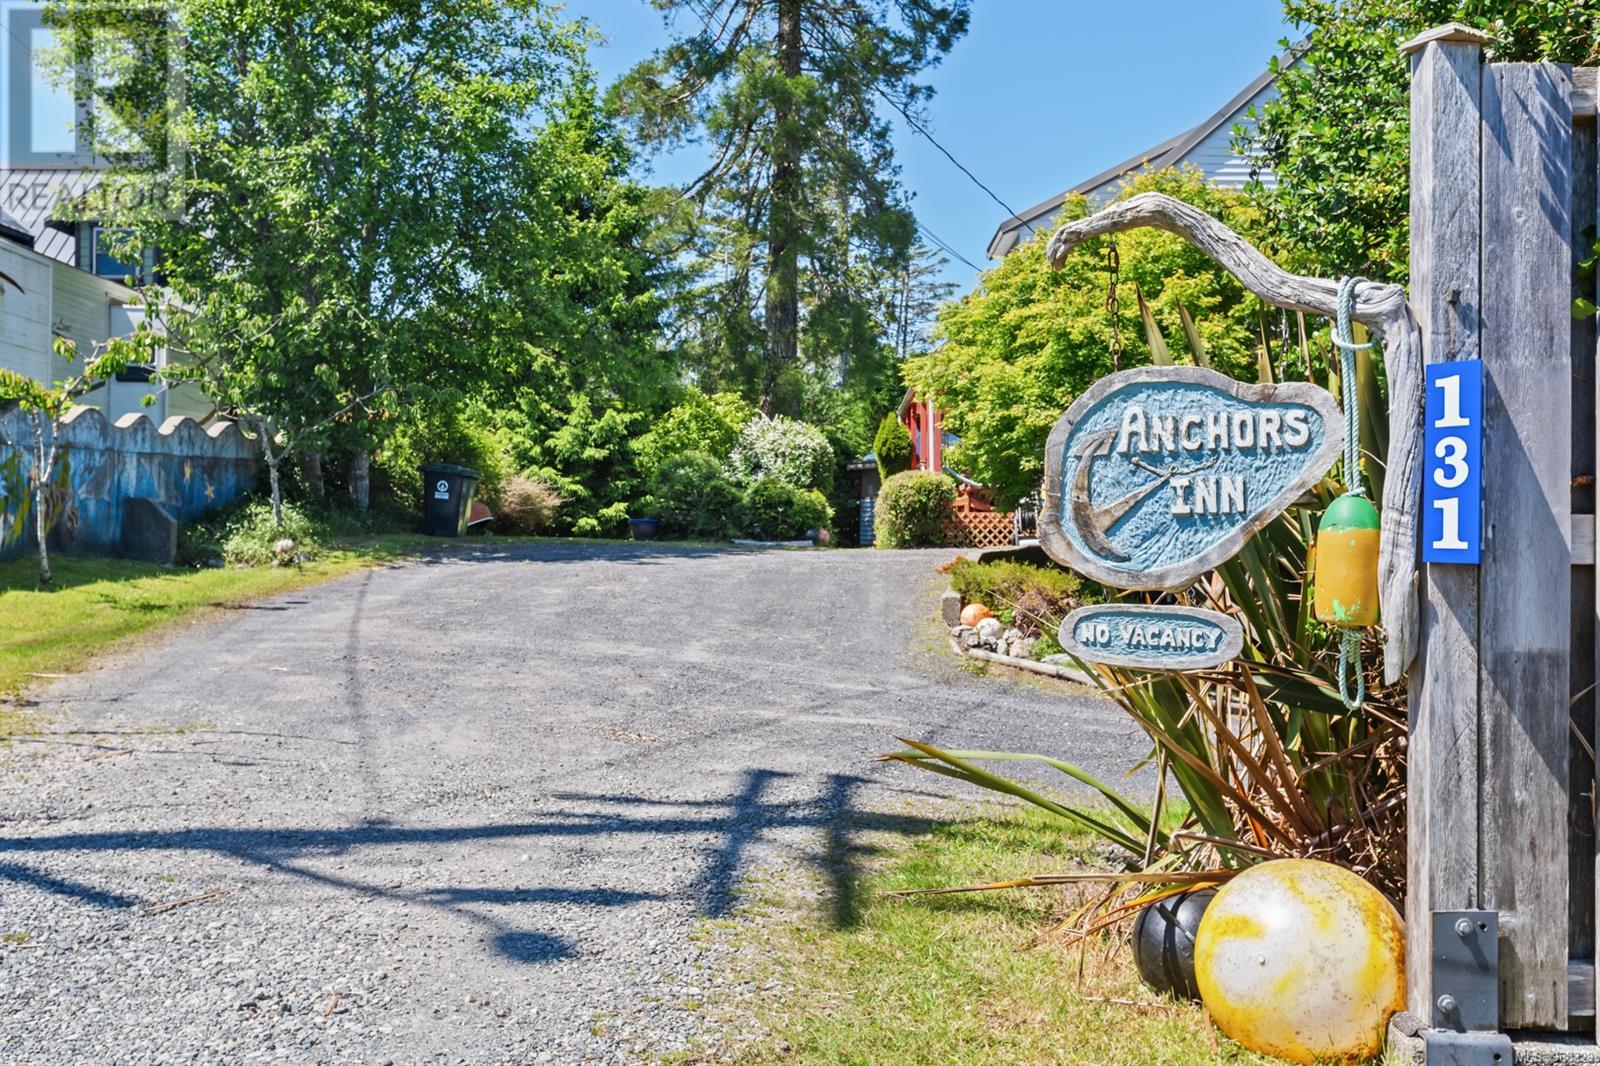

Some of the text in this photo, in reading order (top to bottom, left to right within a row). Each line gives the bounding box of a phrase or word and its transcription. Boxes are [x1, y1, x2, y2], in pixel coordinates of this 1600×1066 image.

[1116, 405, 1311, 453] ANCHORS
[1432, 374, 1470, 550] 131
[1169, 476, 1246, 516] INN
[1080, 622, 1223, 649] NO VACANCY
